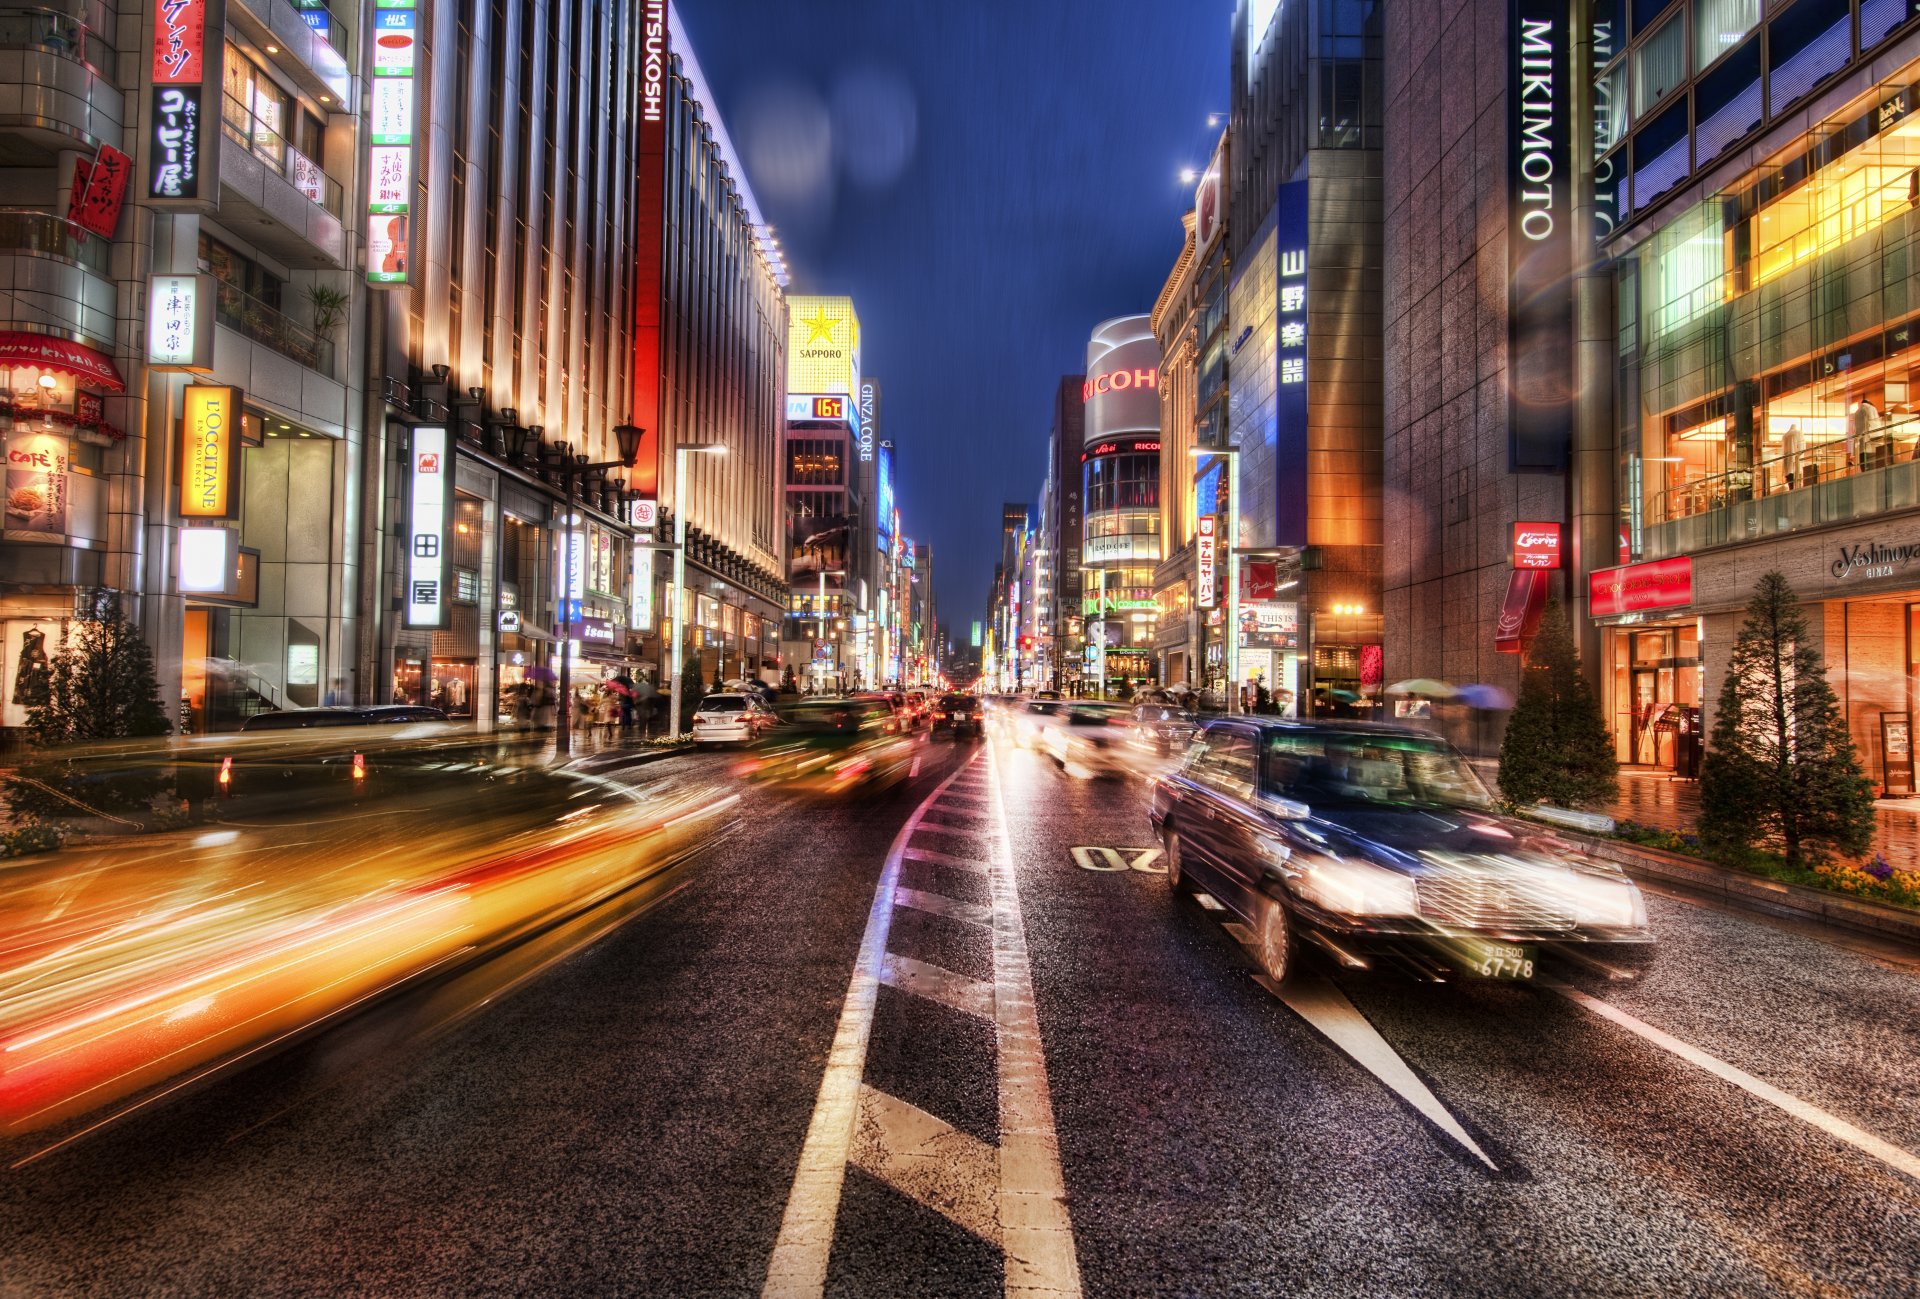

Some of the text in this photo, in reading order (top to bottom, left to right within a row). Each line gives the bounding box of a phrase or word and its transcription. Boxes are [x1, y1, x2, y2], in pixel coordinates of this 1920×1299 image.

[384, 14, 407, 27] HIS
[644, 0, 662, 120] ITSUKOSHI
[154, 90, 185, 196] コーヒー屋
[1521, 18, 1553, 241] MIKIMOTO
[380, 154, 391, 187] すみか
[382, 204, 399, 212] 4F
[380, 273, 397, 281] 3F
[1281, 248, 1305, 384] 山野楽器
[799, 350, 842, 359] SAPPORO
[1082, 368, 1157, 403] RICOH
[860, 384, 873, 462] GINZA CORE
[194, 437, 203, 489] PROVENCE
[202, 400, 223, 509] L'OCCITANE
[412, 533, 439, 605] 田屋
[1200, 540, 1212, 603] キムラヤのパン
[1831, 541, 1920, 579] Yoshinoya
[1866, 565, 1893, 578] GINZA
[1251, 581, 1274, 595] Fender
[1261, 614, 1293, 623] THIS IS
[1481, 958, 1533, 979] 67-78
